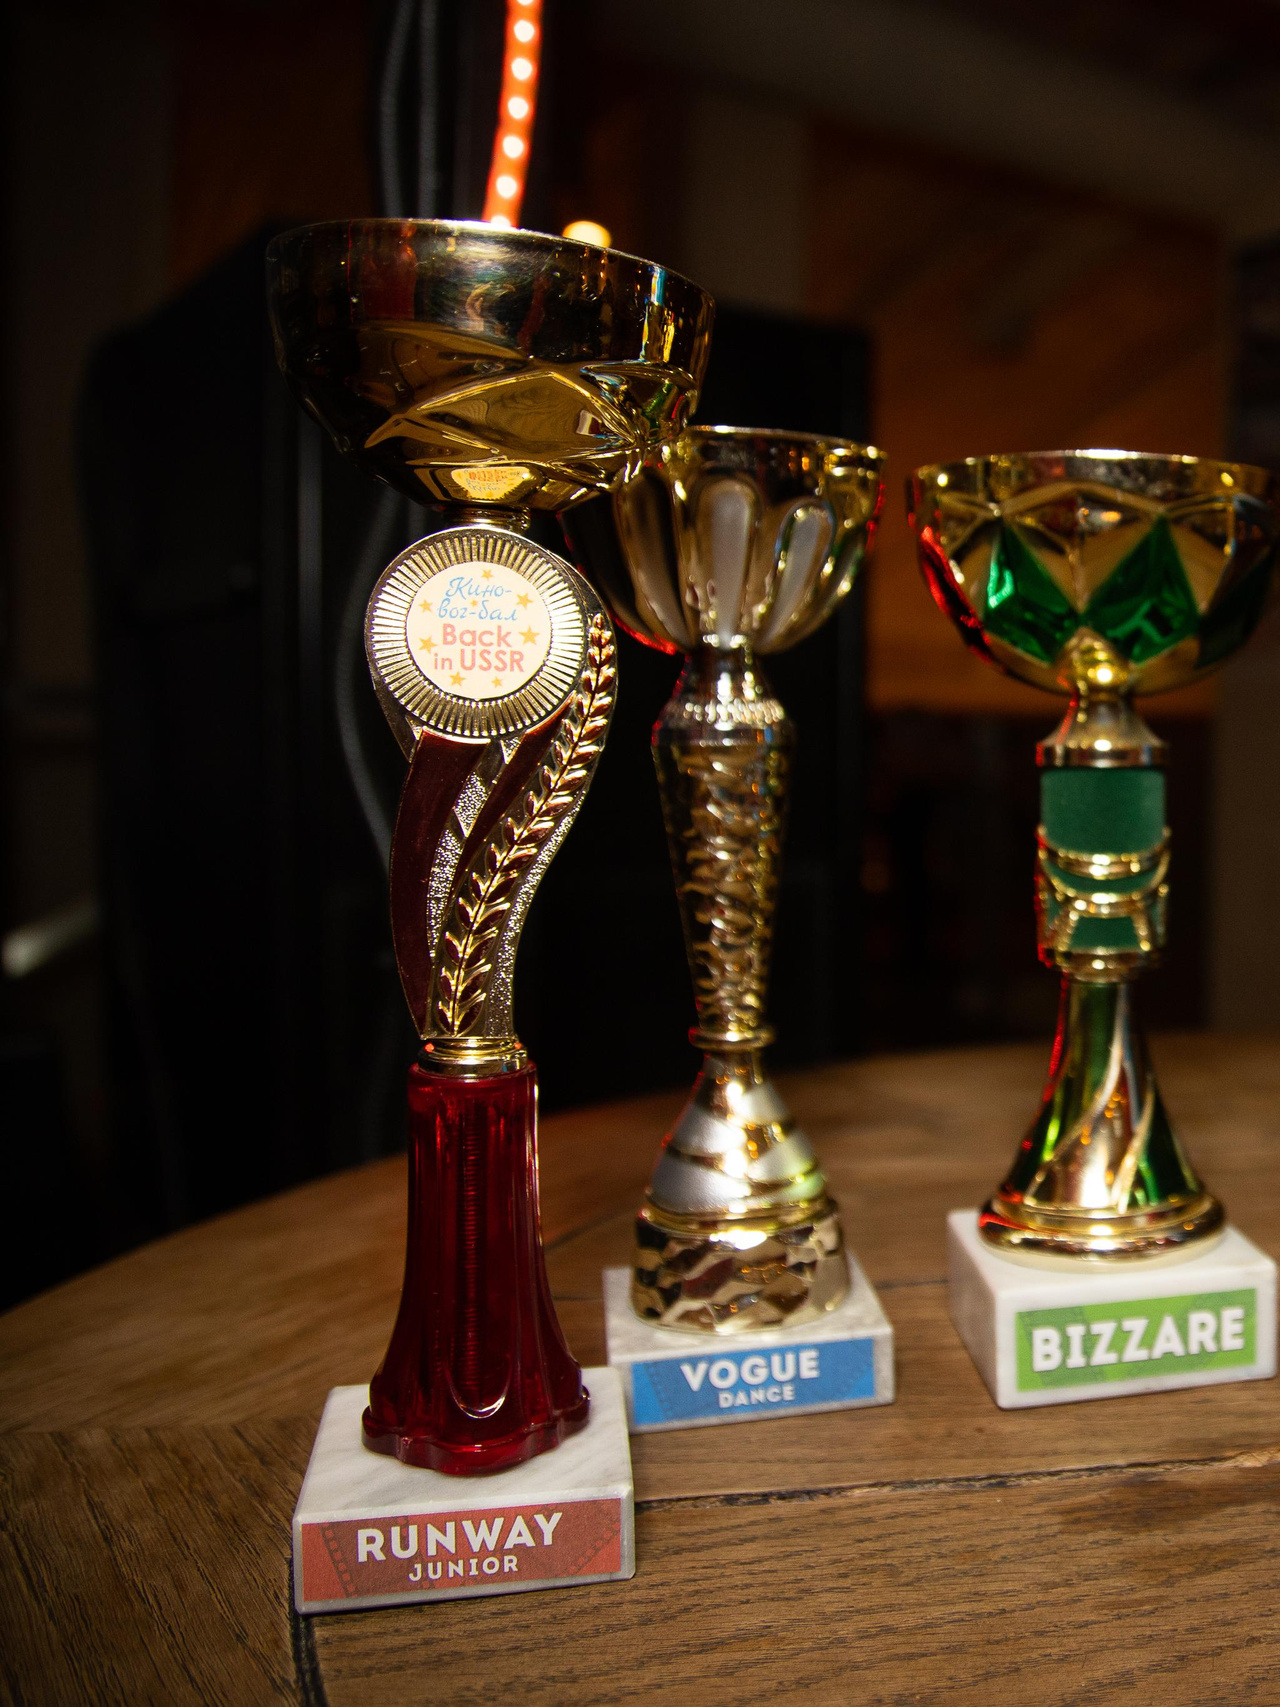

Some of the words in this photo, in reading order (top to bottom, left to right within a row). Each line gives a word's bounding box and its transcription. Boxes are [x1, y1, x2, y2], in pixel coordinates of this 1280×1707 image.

[445, 576, 512, 598] Кино-
[437, 598, 518, 621] вог-бал
[442, 623, 513, 648] Back
[433, 653, 452, 671] in
[459, 649, 525, 673] USSR
[1031, 1308, 1245, 1372] BIZZARE
[680, 1349, 820, 1392] VOGUE
[719, 1384, 795, 1409] DANCE
[357, 1512, 562, 1563] RUNWAY
[408, 1555, 519, 1582] JUNIOR
